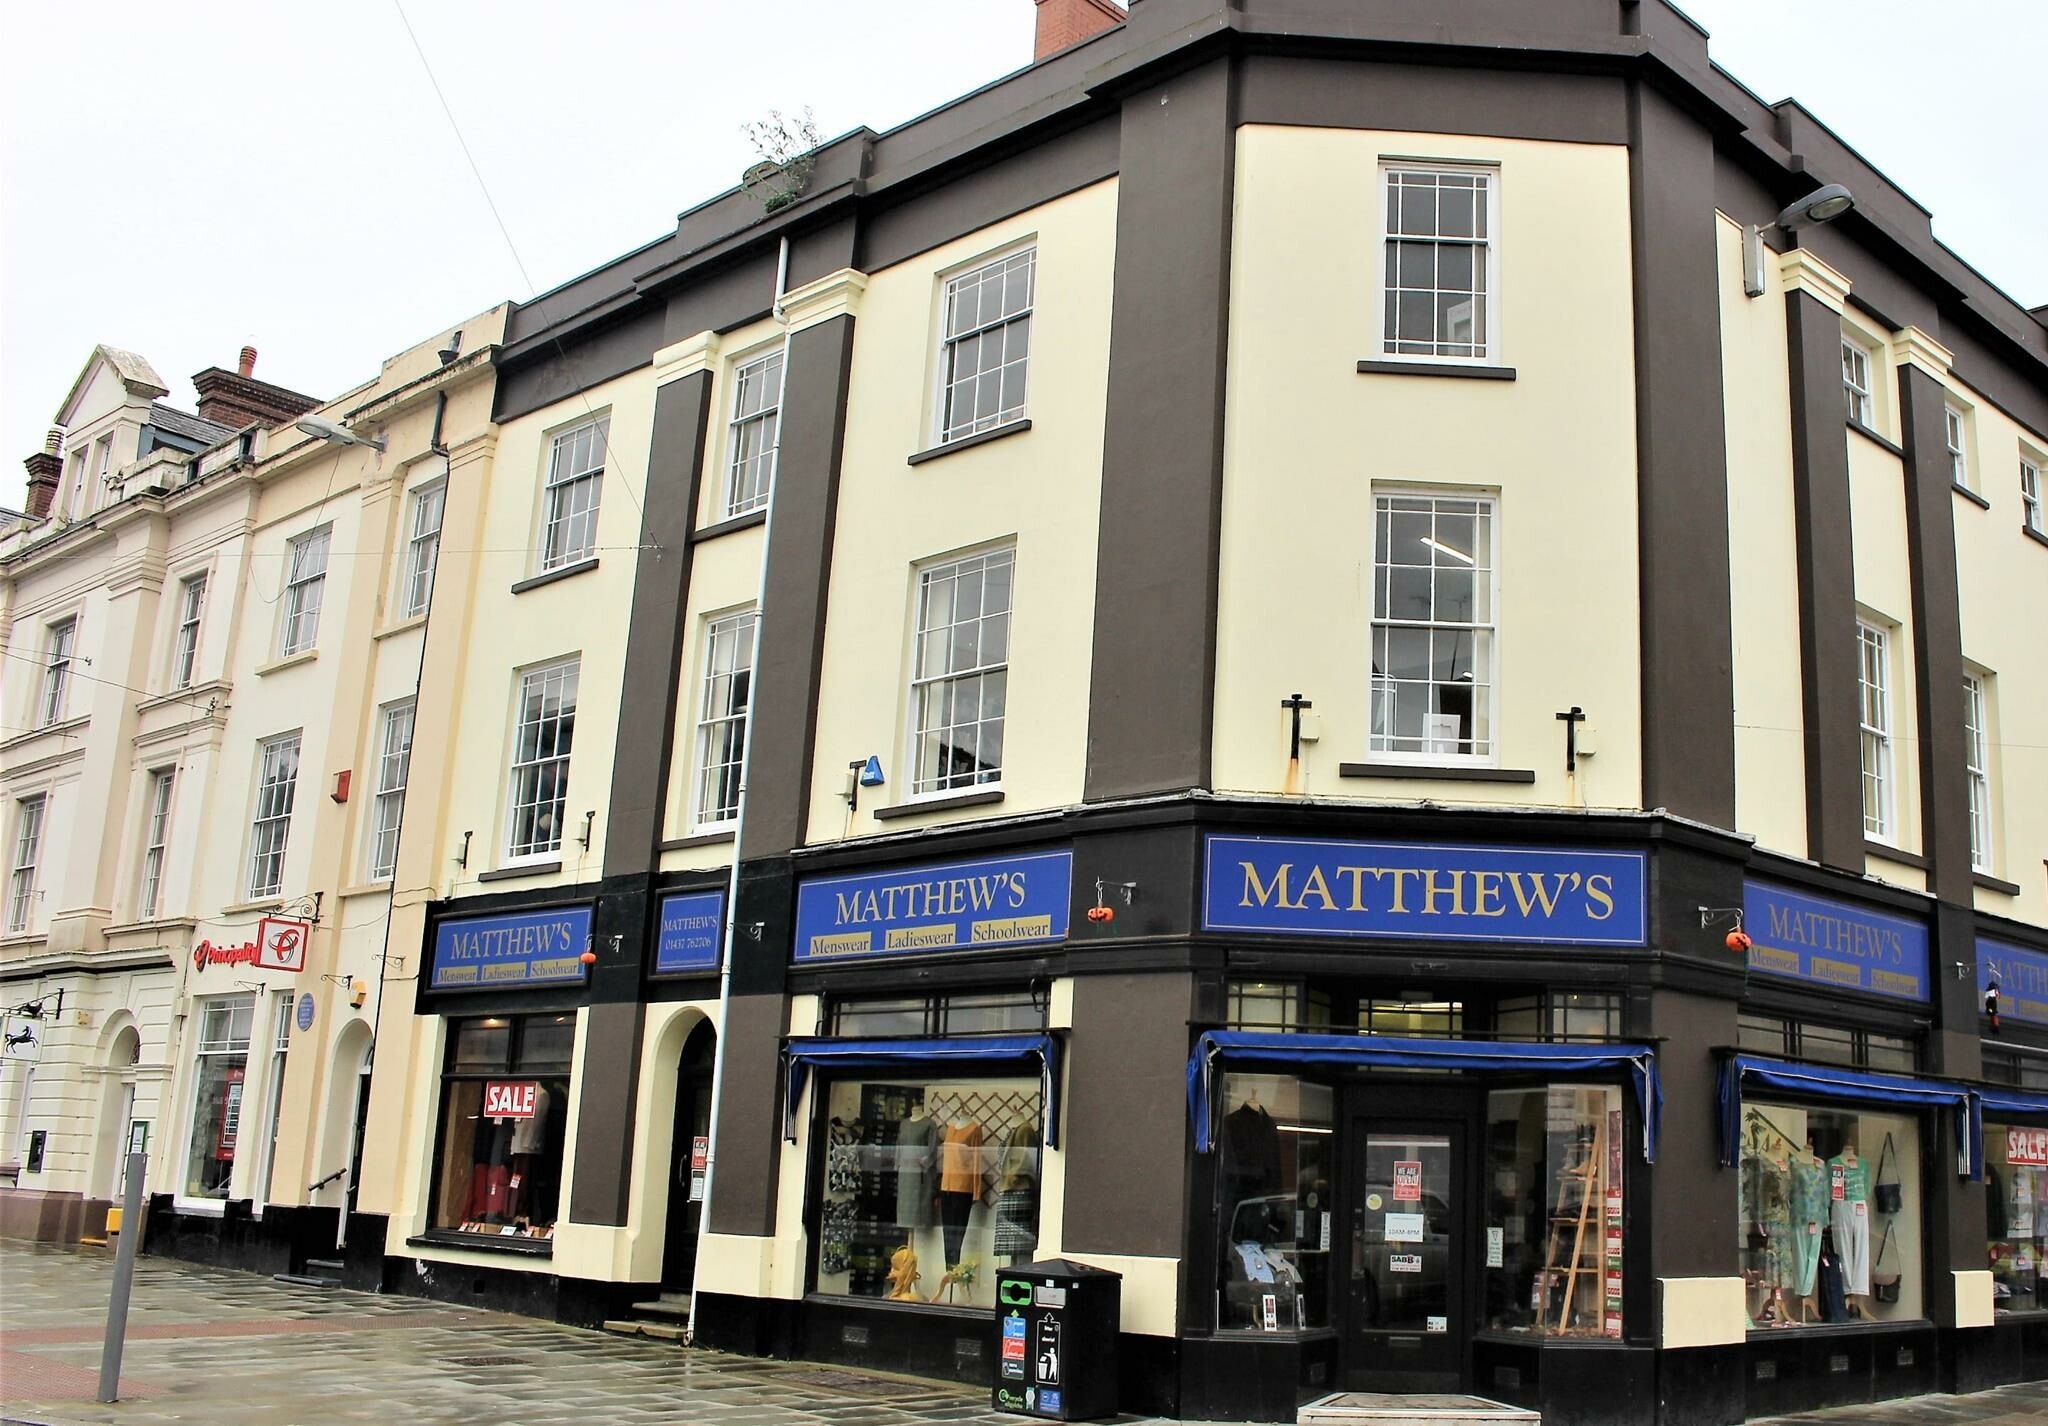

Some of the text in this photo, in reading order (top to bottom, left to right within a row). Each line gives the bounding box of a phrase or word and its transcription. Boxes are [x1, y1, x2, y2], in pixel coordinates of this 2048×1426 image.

[834, 872, 1026, 925] MATTHEW'S
[1238, 861, 1615, 920] MATTHEW'S
[664, 915, 718, 932] MATTHEW'S
[812, 921, 1049, 955] Menswear Ladieswear Schoolwear
[1768, 903, 1902, 965] MATTHEW'S
[451, 922, 572, 960] MATTHEW'S
[440, 962, 577, 984] Menswear Ladieswear Schoolwear
[487, 1086, 535, 1113] SALE
[2008, 1131, 2047, 1161] SALE
